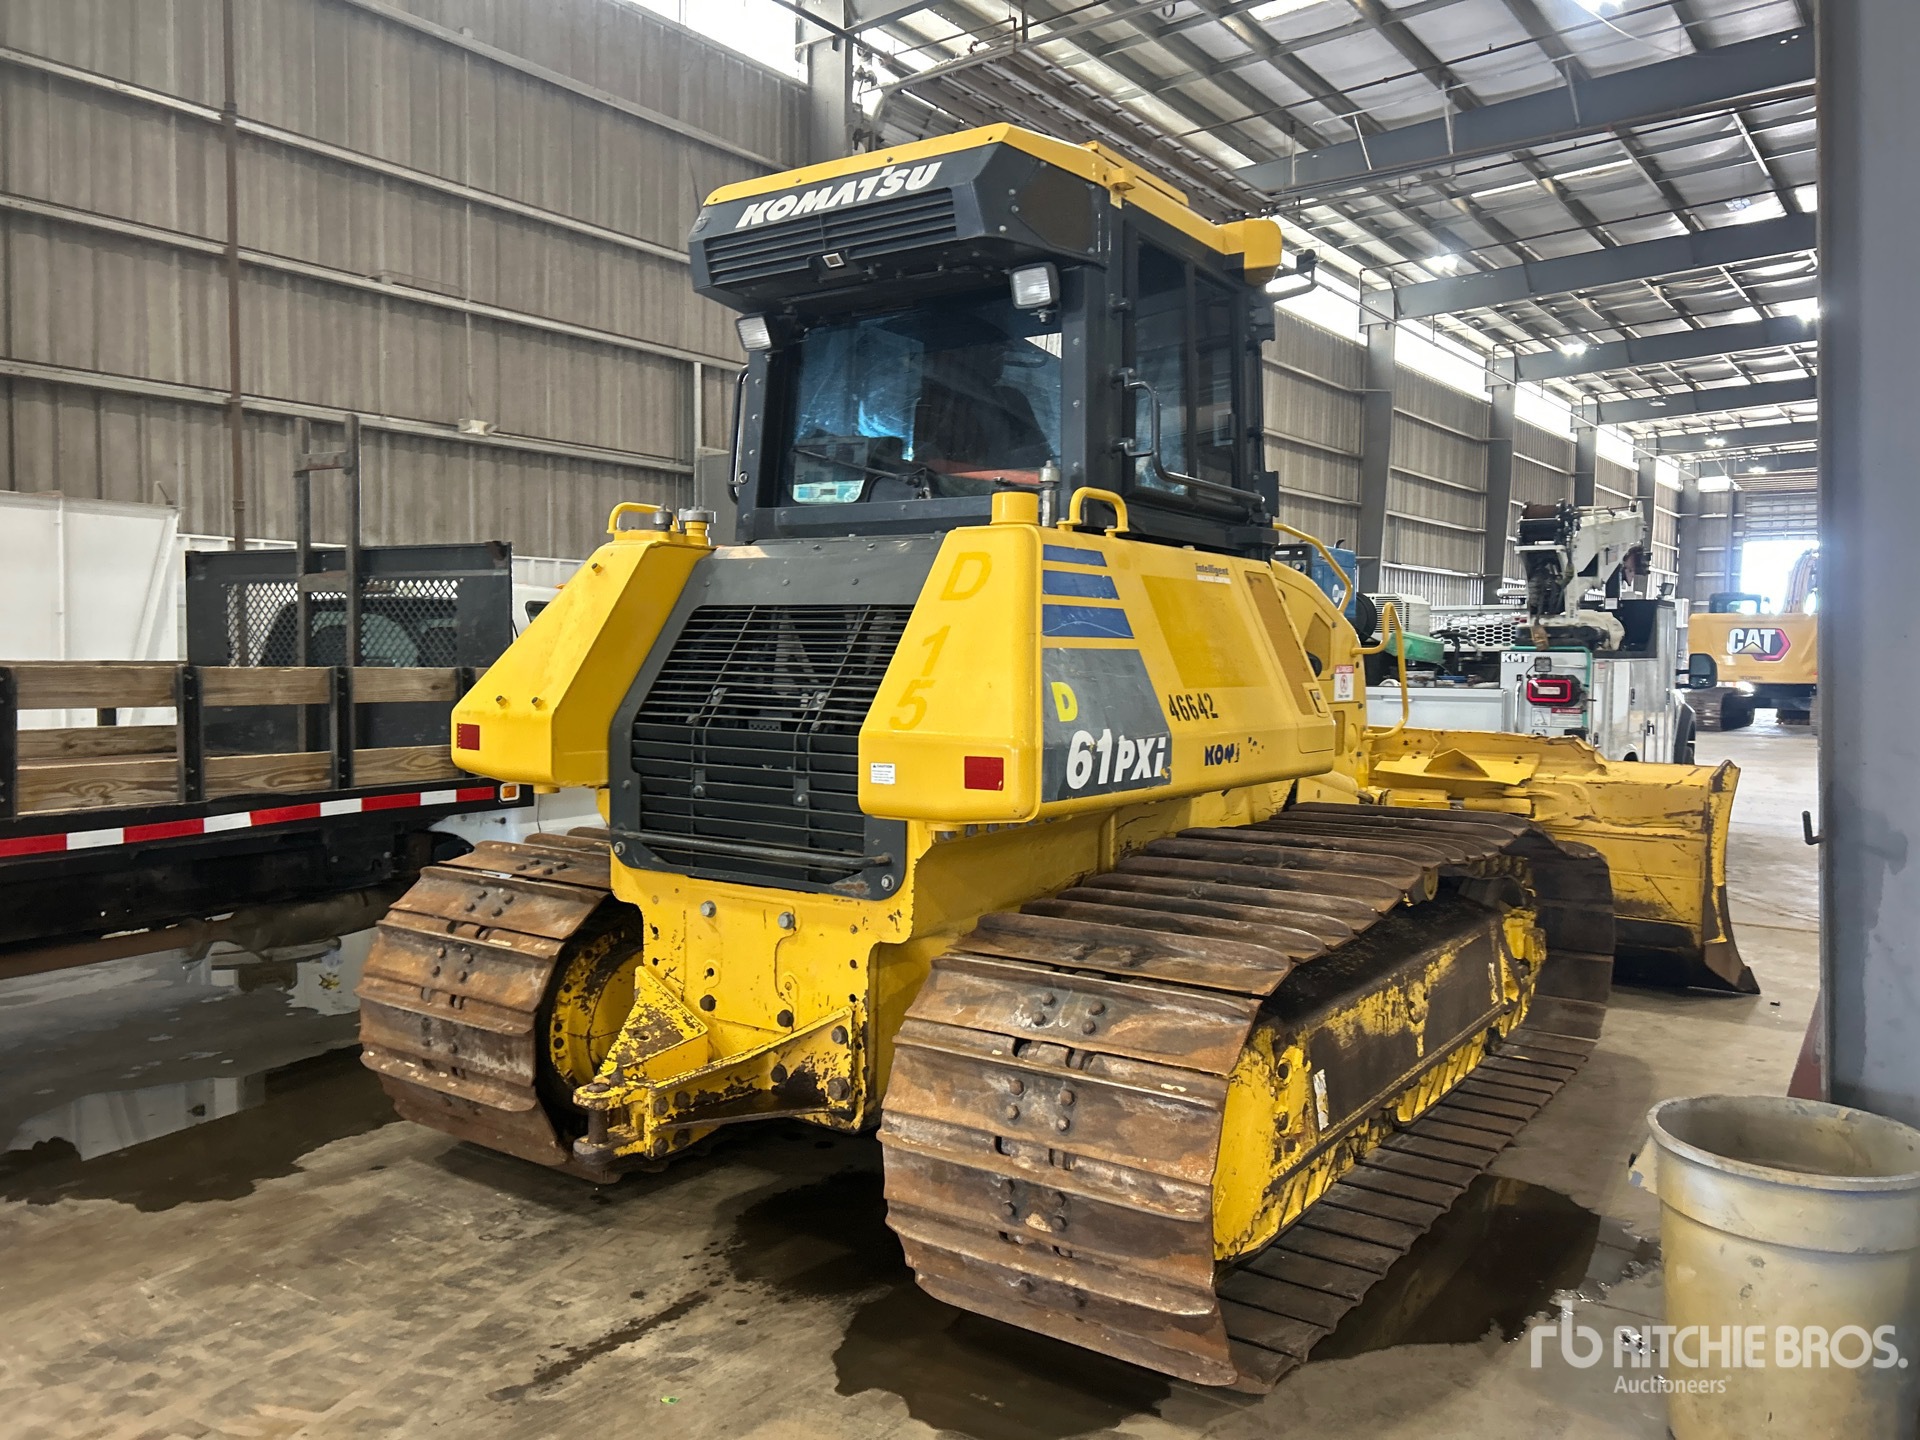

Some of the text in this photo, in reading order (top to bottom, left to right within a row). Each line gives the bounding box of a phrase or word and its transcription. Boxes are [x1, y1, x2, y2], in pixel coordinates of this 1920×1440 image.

[735, 161, 942, 229] KOMATSU
[1727, 628, 1776, 655] CAT
[1501, 653, 1531, 663] KMT
[1168, 692, 1219, 722] 46642
